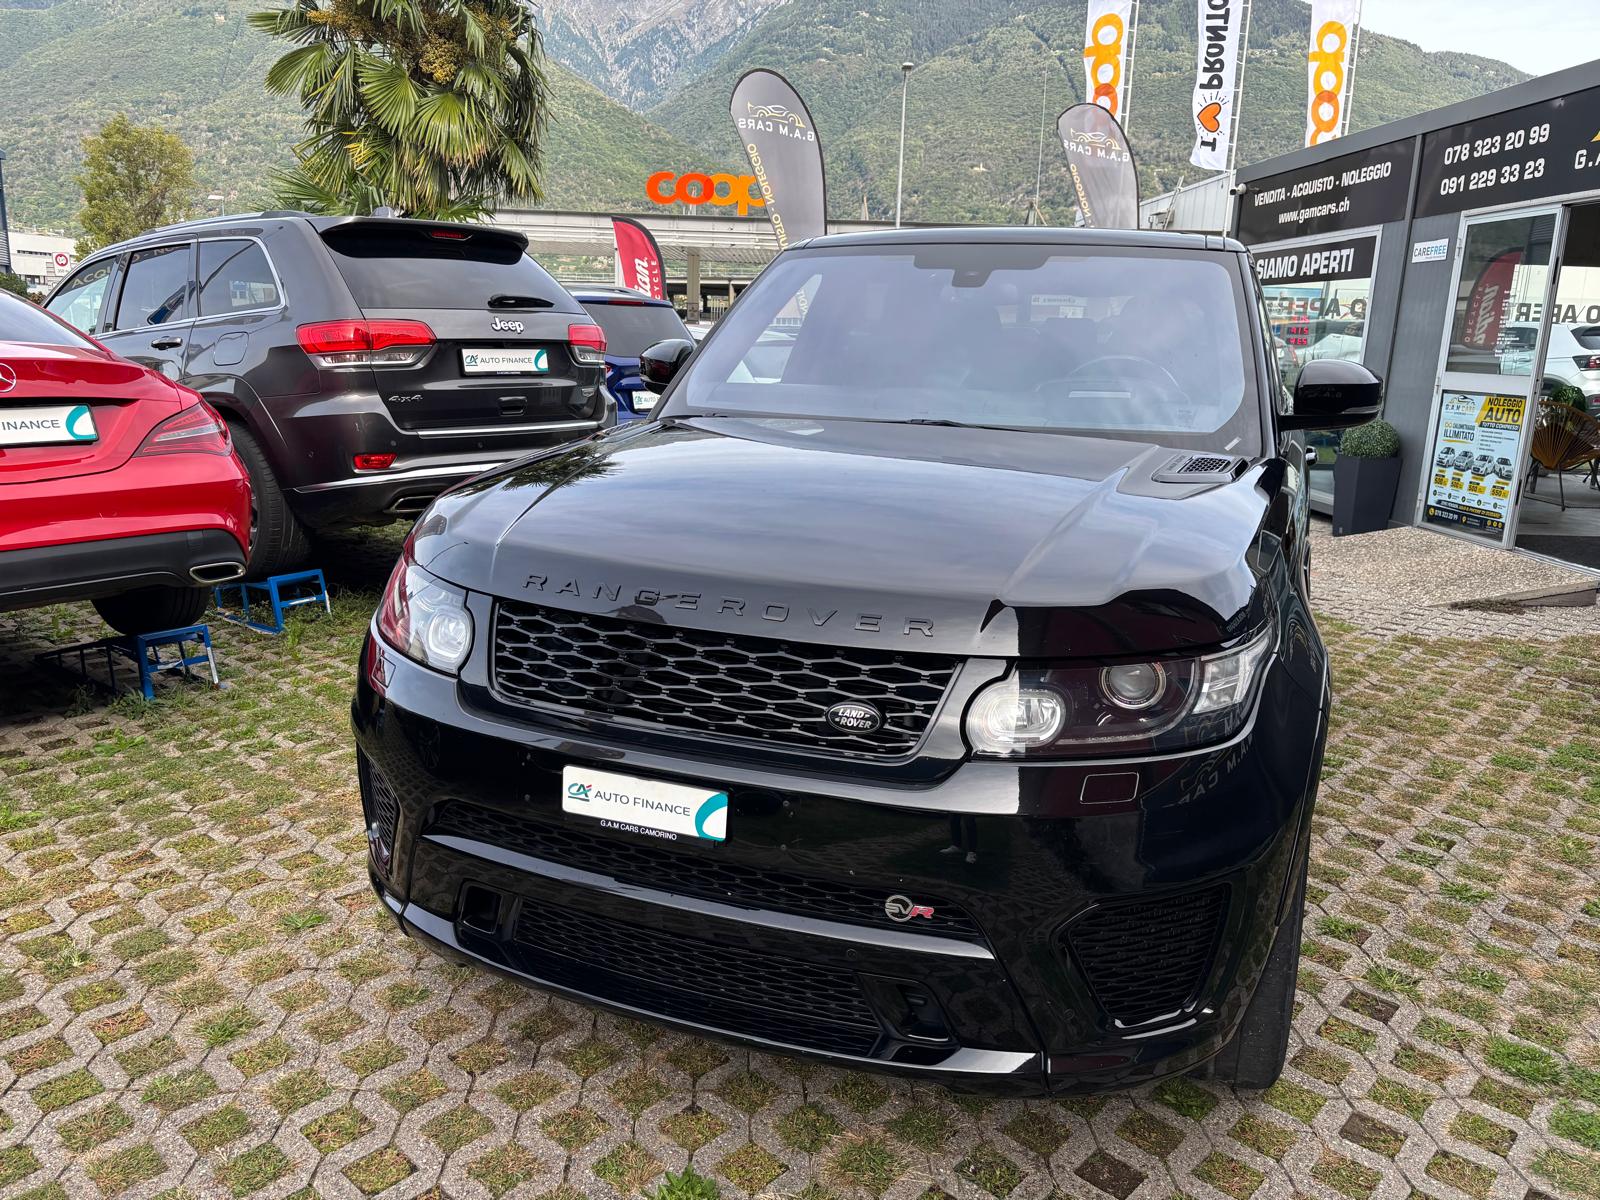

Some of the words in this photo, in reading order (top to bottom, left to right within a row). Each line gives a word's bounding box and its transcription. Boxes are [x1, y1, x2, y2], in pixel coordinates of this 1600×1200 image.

[1444, 143, 1470, 165] 078
[1473, 135, 1501, 158] 323
[1504, 129, 1525, 151] 20
[1528, 123, 1550, 145] 99
[1254, 187, 1286, 207] VENDITA
[1291, 176, 1334, 199] ACQUISTO
[1341, 161, 1392, 187] NOLEGGIO
[1440, 174, 1466, 196] 091
[1469, 168, 1497, 190] 229
[1500, 163, 1521, 184] 33
[1523, 158, 1546, 180] 23
[645, 170, 765, 217] coop
[1278, 197, 1350, 224] www.gamcars.ch
[1256, 254, 1298, 280] SIAMO
[1300, 248, 1355, 276] APERTI
[1413, 244, 1447, 258] CAREFREE
[492, 317, 524, 334] Jeep
[1484, 407, 1522, 424] AUTO
[1487, 397, 1523, 408] NOLEGGIO
[2, 419, 61, 431] INANCE
[521, 574, 703, 611] RANGE
[716, 595, 935, 637] ROVER
[594, 790, 630, 805] AUTO
[633, 797, 691, 817] FINANCE
[600, 819, 619, 830] G.A.M
[620, 823, 639, 834] CARS
[640, 827, 677, 841] CAMORINO
